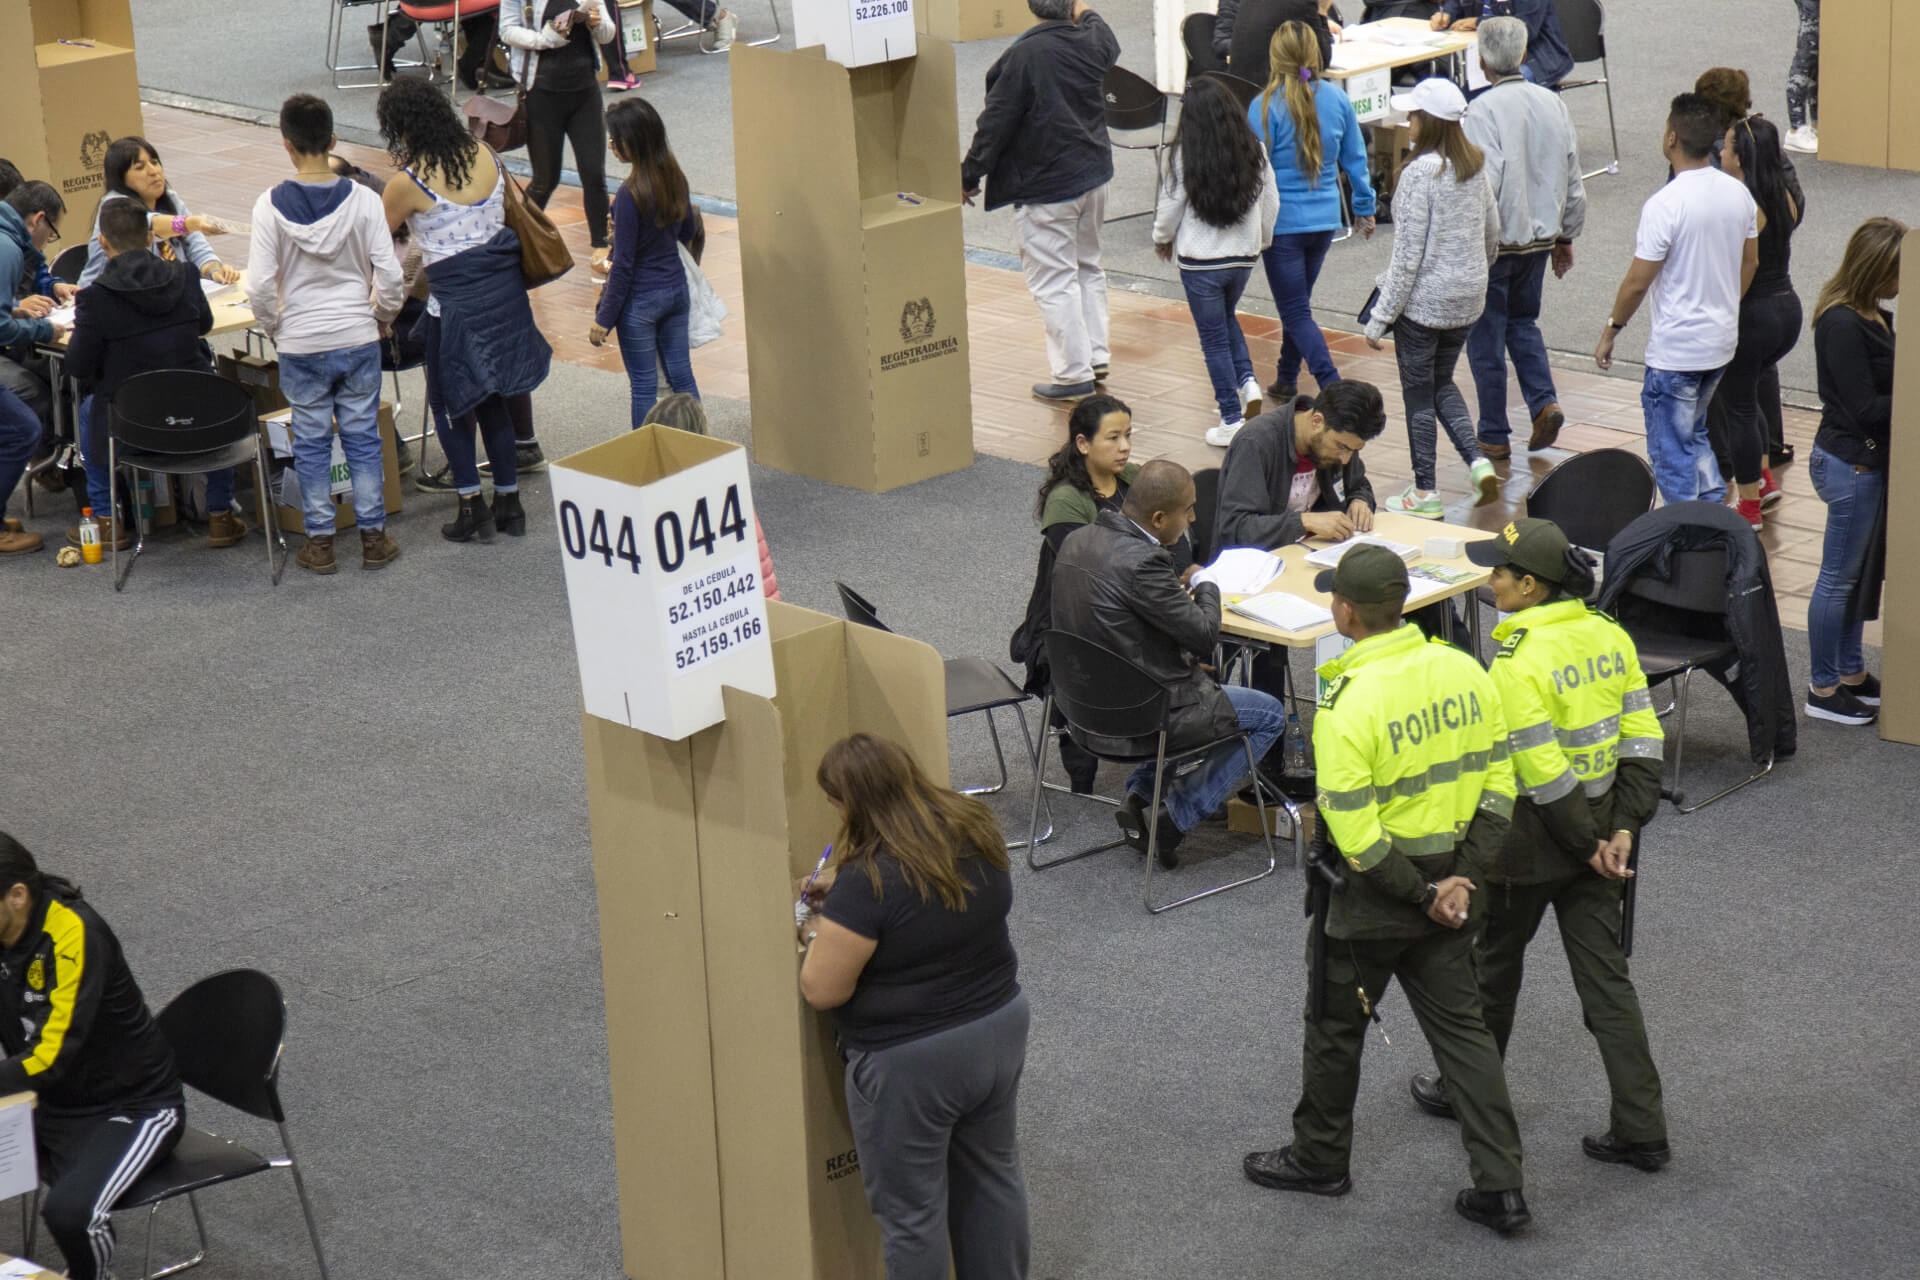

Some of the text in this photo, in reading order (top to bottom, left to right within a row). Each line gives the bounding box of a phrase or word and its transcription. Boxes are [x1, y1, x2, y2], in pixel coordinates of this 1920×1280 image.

[856, 0, 909, 20] 52.226.100
[880, 335, 958, 365] REGISTRADURÍA
[559, 500, 641, 574] 044
[654, 483, 747, 573] 044
[668, 573, 756, 625] 52.150.442
[682, 583, 693, 595] DE
[695, 579, 705, 590] LA
[675, 617, 761, 669] 52.159.166
[682, 625, 707, 643] HASTA
[708, 620, 718, 632] LA
